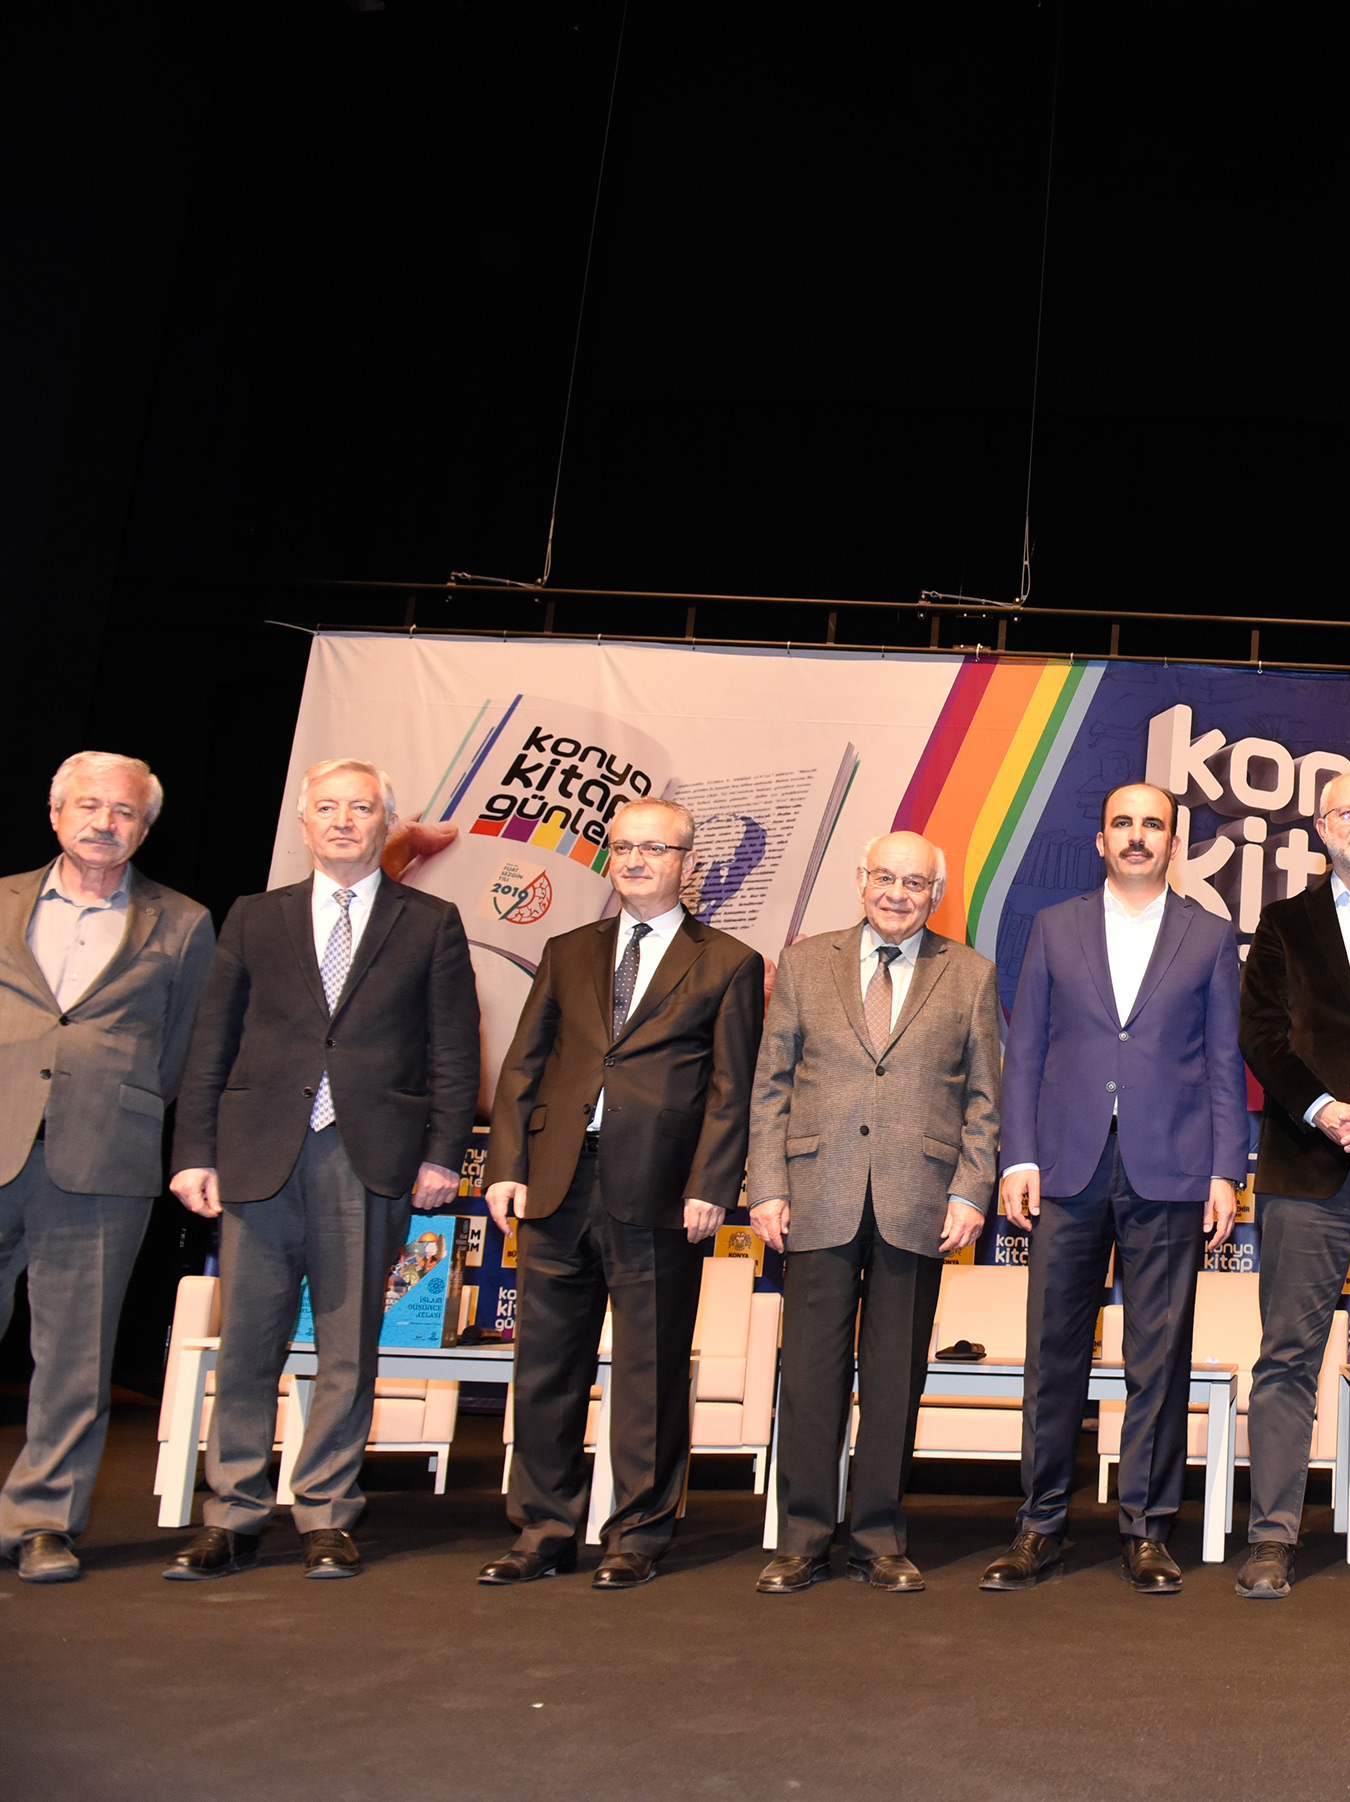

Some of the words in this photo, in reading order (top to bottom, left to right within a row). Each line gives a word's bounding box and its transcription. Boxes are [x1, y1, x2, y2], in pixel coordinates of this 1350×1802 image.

[522, 726, 651, 797] konya
[478, 794, 609, 849] günle
[1204, 1254, 1253, 1273] kitap
